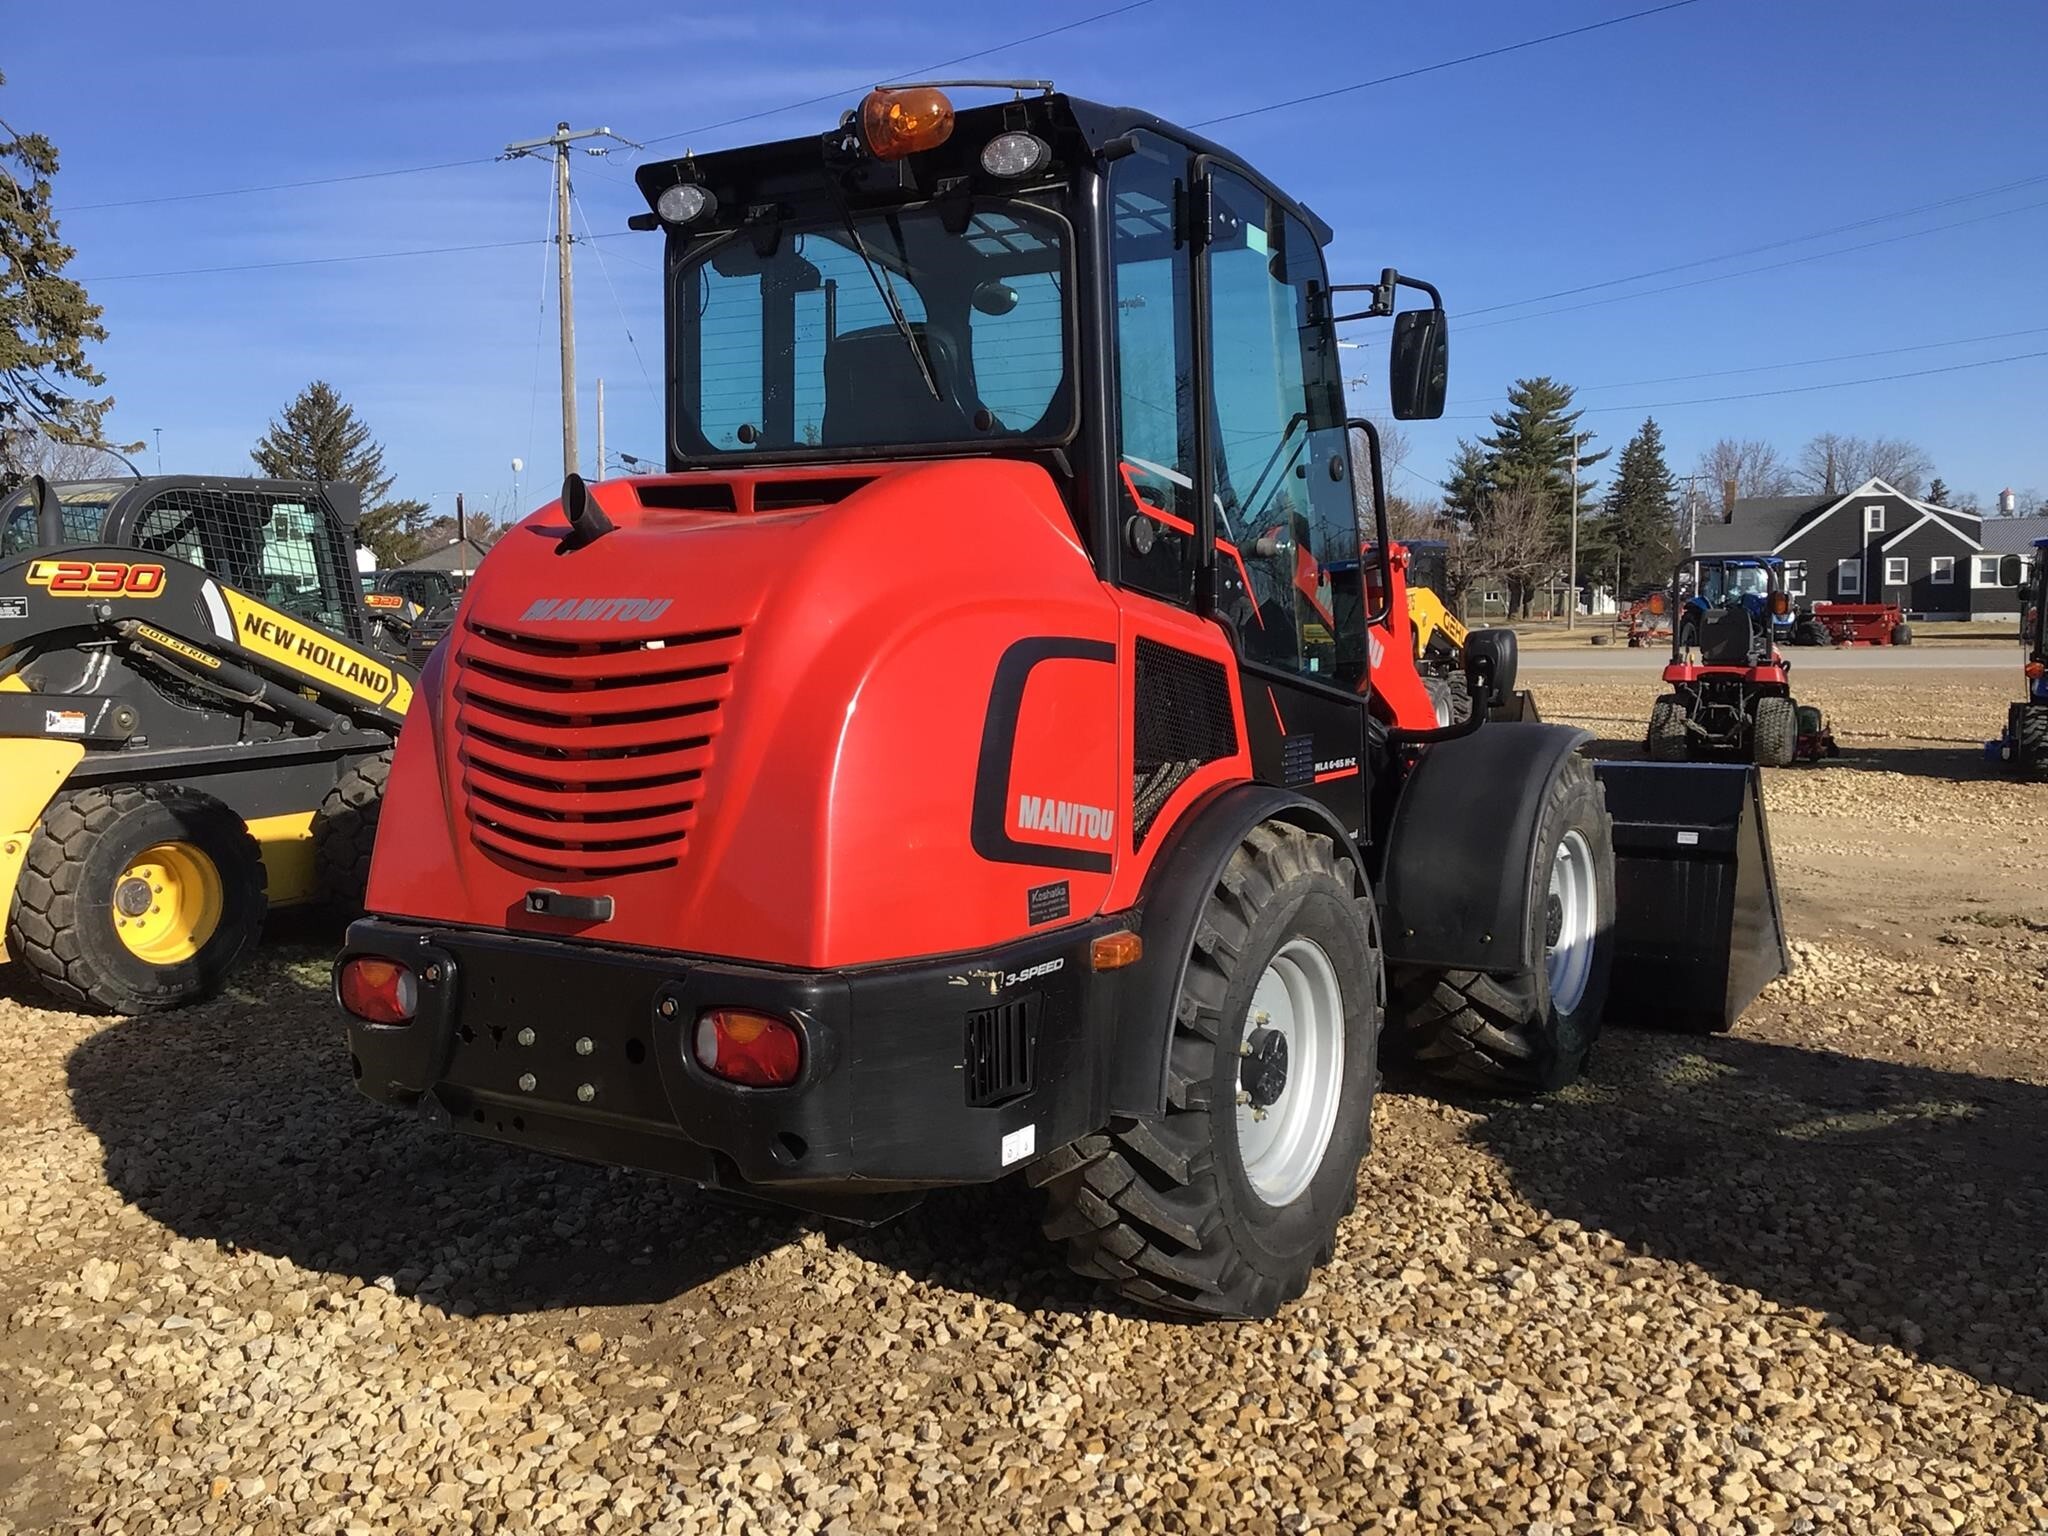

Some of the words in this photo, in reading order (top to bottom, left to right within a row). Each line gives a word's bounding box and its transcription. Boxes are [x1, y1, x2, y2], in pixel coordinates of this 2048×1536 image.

[28, 562, 165, 594] L230
[519, 598, 674, 622] MANITOU
[140, 627, 168, 644] 200
[170, 641, 219, 667] SERIES
[243, 612, 296, 650] NEW
[297, 638, 389, 693] HOLLAND
[1018, 794, 1114, 841] MANITOU
[1005, 957, 1064, 987] 3-SPEED
